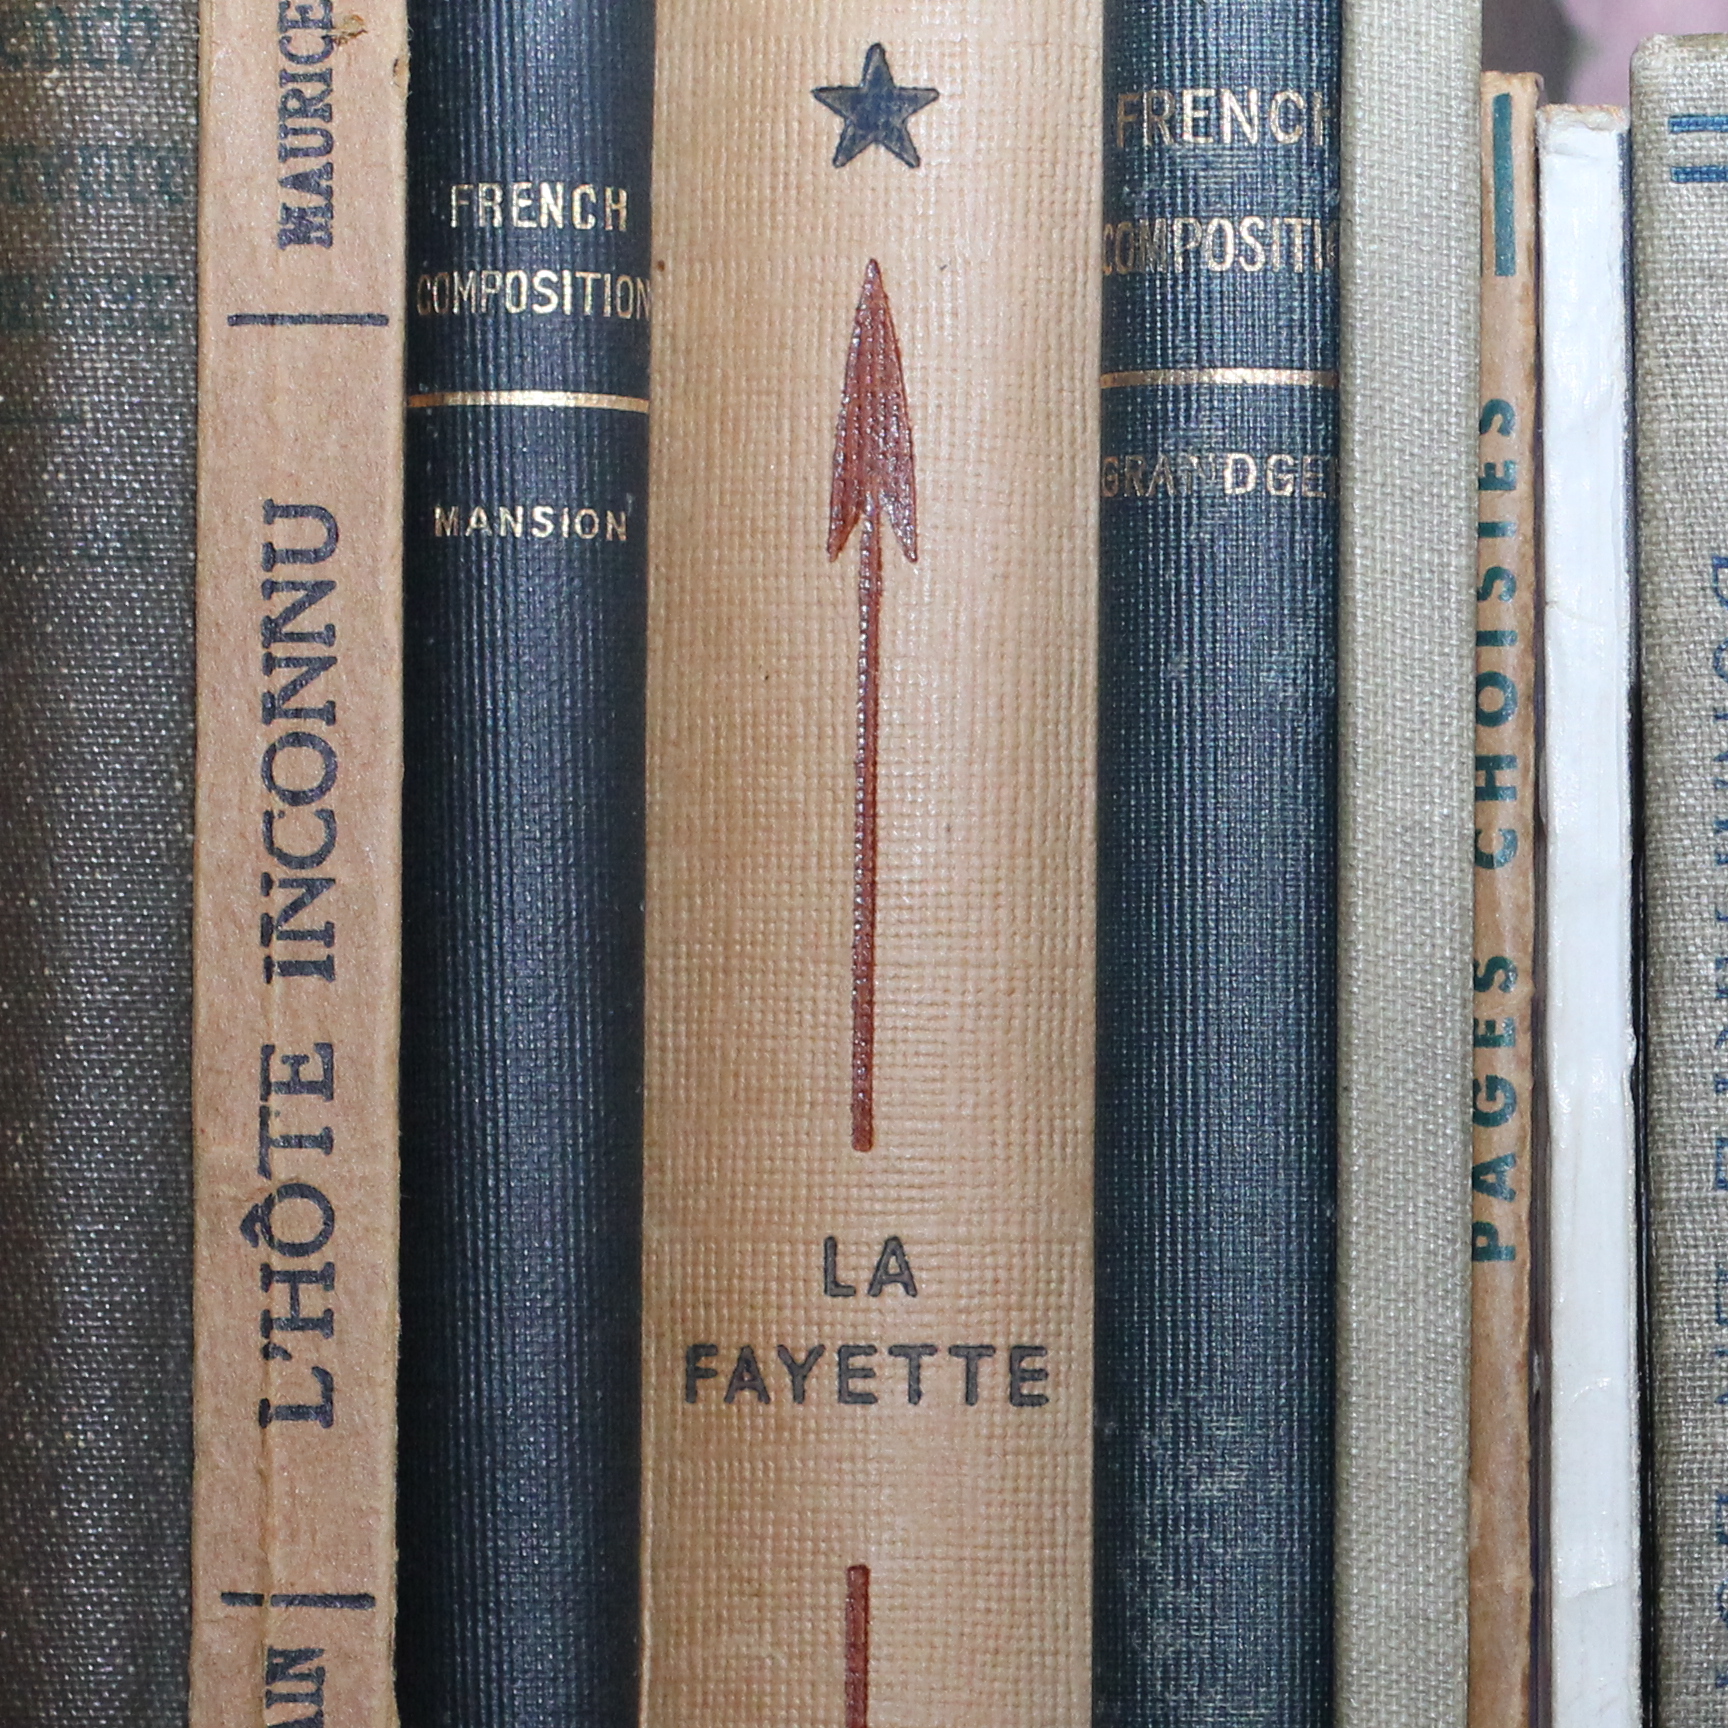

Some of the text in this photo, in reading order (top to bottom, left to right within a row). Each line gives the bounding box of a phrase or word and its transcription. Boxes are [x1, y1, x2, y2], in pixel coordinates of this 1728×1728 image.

[279, 0, 334, 250] MAURICE
[449, 181, 628, 232] FRENCH
[416, 269, 652, 322] COMPOSITION
[432, 504, 629, 542] MANSION
[1471, 398, 1518, 1263] PAGES CHOISIES
[239, 498, 339, 1429] L'HÔTE INCONNU
[823, 1236, 919, 1298] LA
[685, 1344, 1050, 1408] FAYETTE
